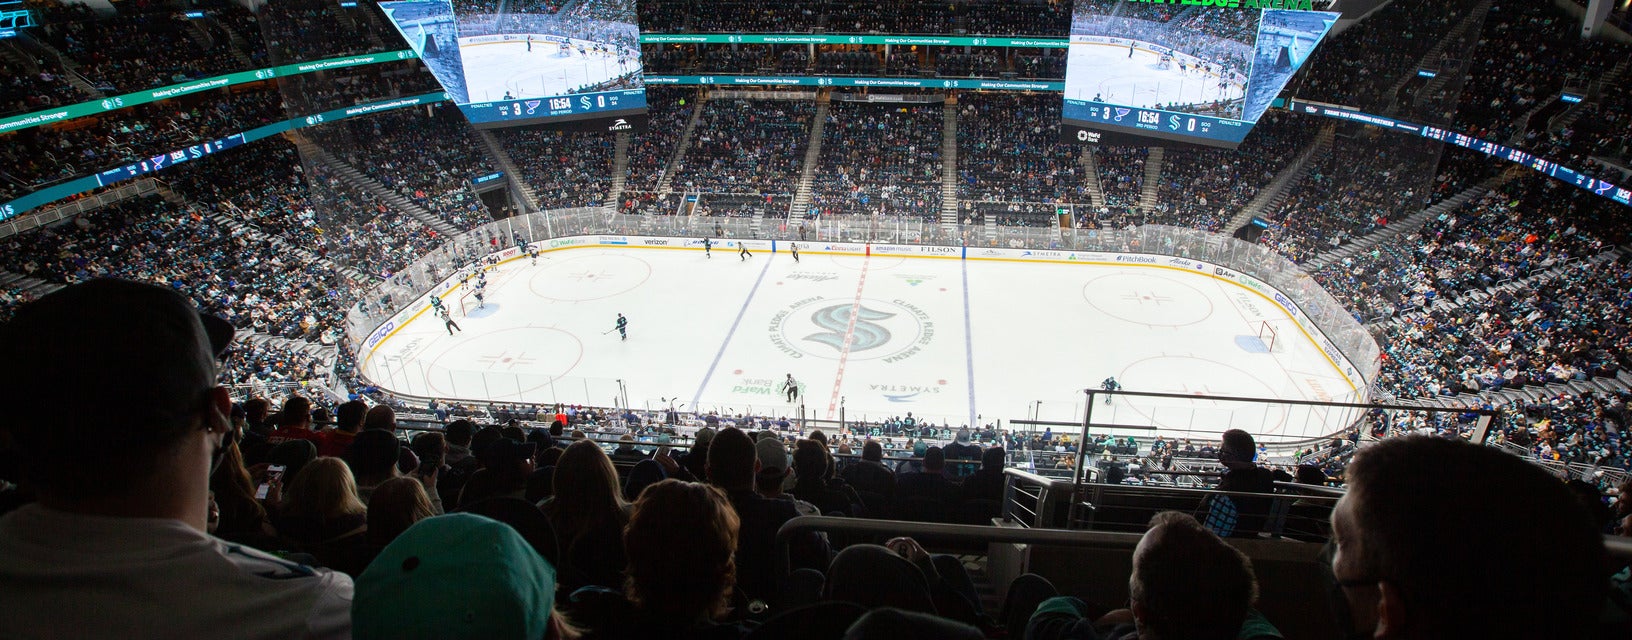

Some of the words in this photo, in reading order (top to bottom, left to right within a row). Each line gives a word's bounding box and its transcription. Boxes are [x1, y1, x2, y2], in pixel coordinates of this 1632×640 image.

[324, 58, 354, 67] Communities
[372, 101, 401, 110] Communities
[549, 98, 571, 110] 16:54
[598, 96, 605, 108] 0
[40, 111, 68, 121] Stronger
[513, 103, 521, 116] 3
[1103, 107, 1110, 120] 3
[1138, 111, 1160, 124] 16:54
[1188, 118, 1196, 131] 0
[1122, 255, 1157, 264] PitchBook
[789, 296, 824, 310] ARENA
[893, 299, 929, 320] CLIMATE
[1275, 293, 1297, 316] GEICO
[769, 310, 789, 332] PLEDGE
[368, 321, 394, 348] GEICO
[918, 321, 934, 346] PLEDGE
[770, 334, 804, 359] CLIMATE
[882, 345, 921, 364] ARENA
[870, 384, 940, 393] SYMETRA
